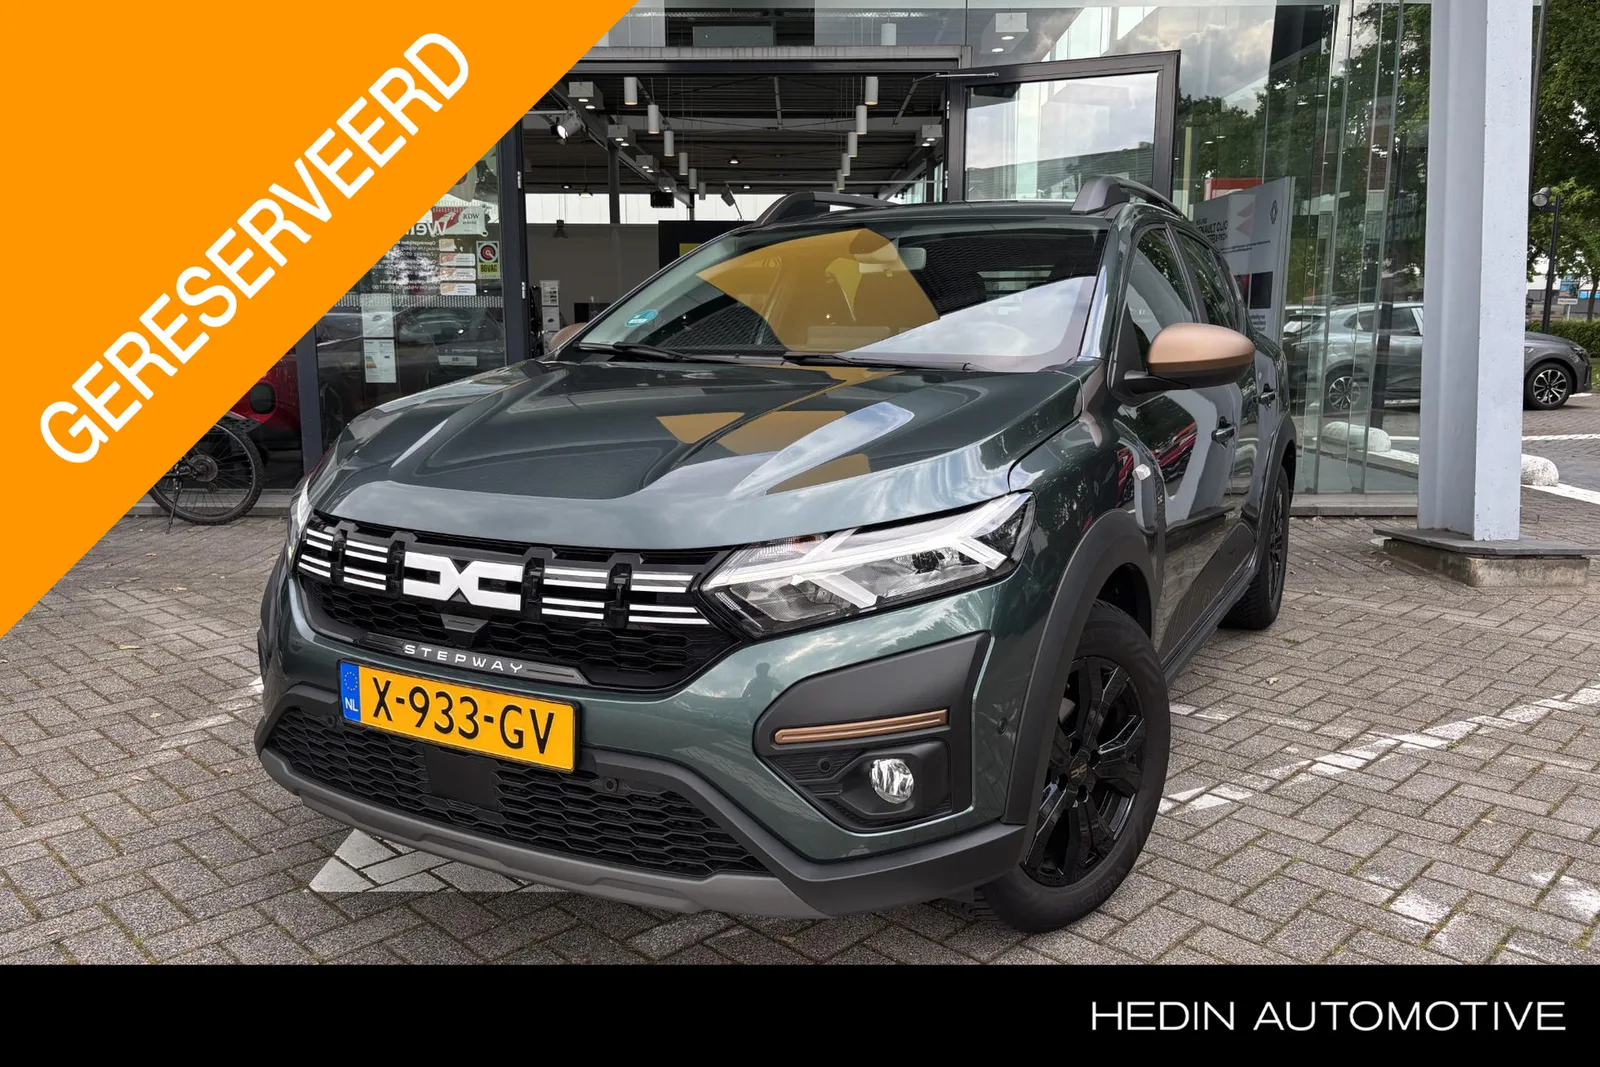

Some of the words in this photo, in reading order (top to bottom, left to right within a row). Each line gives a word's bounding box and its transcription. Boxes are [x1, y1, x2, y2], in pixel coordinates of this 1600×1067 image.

[480, 264, 498, 273] BOVAG
[404, 644, 524, 674] STEPWAY
[345, 697, 359, 712] NL
[371, 677, 555, 755] X-933-GV
